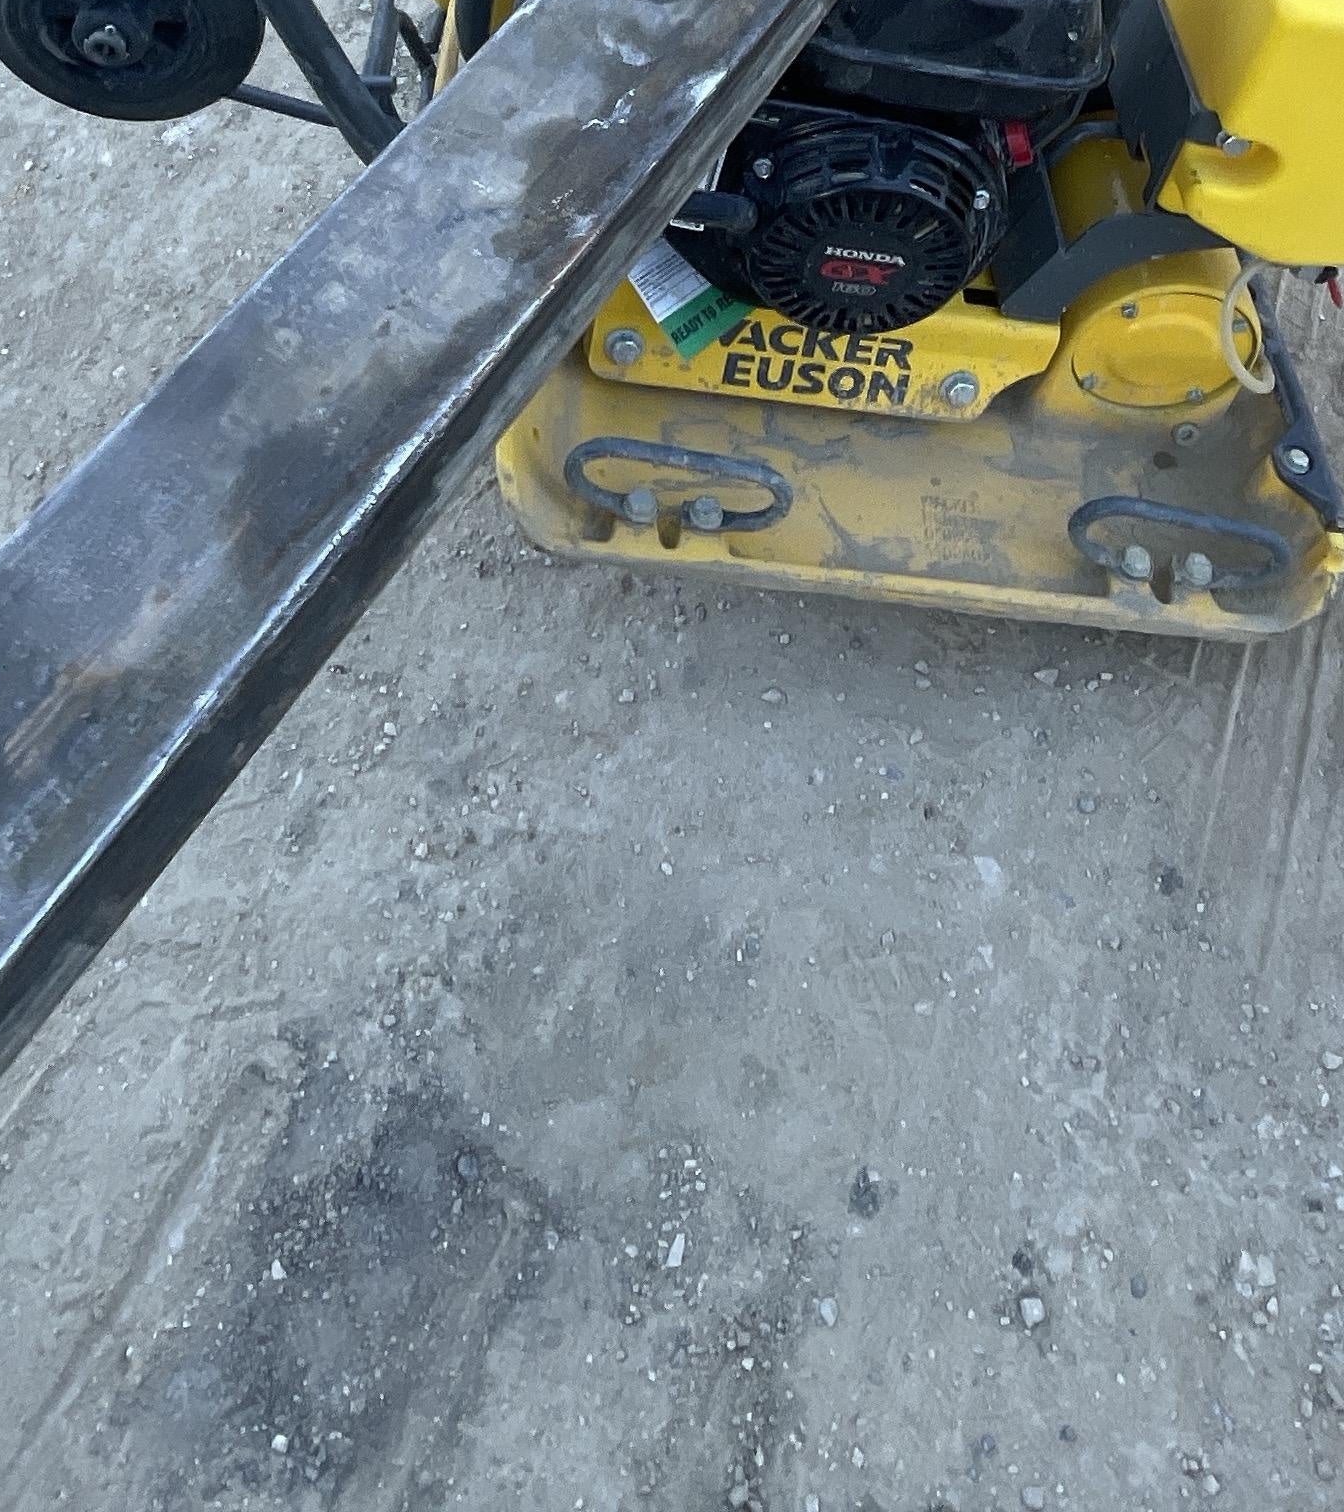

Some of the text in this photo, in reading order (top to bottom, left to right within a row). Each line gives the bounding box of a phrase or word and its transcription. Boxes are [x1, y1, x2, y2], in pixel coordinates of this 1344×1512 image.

[823, 245, 906, 268] HONDA
[670, 313, 704, 345] READY
[701, 304, 718, 322] TO
[719, 319, 913, 371] ACKER
